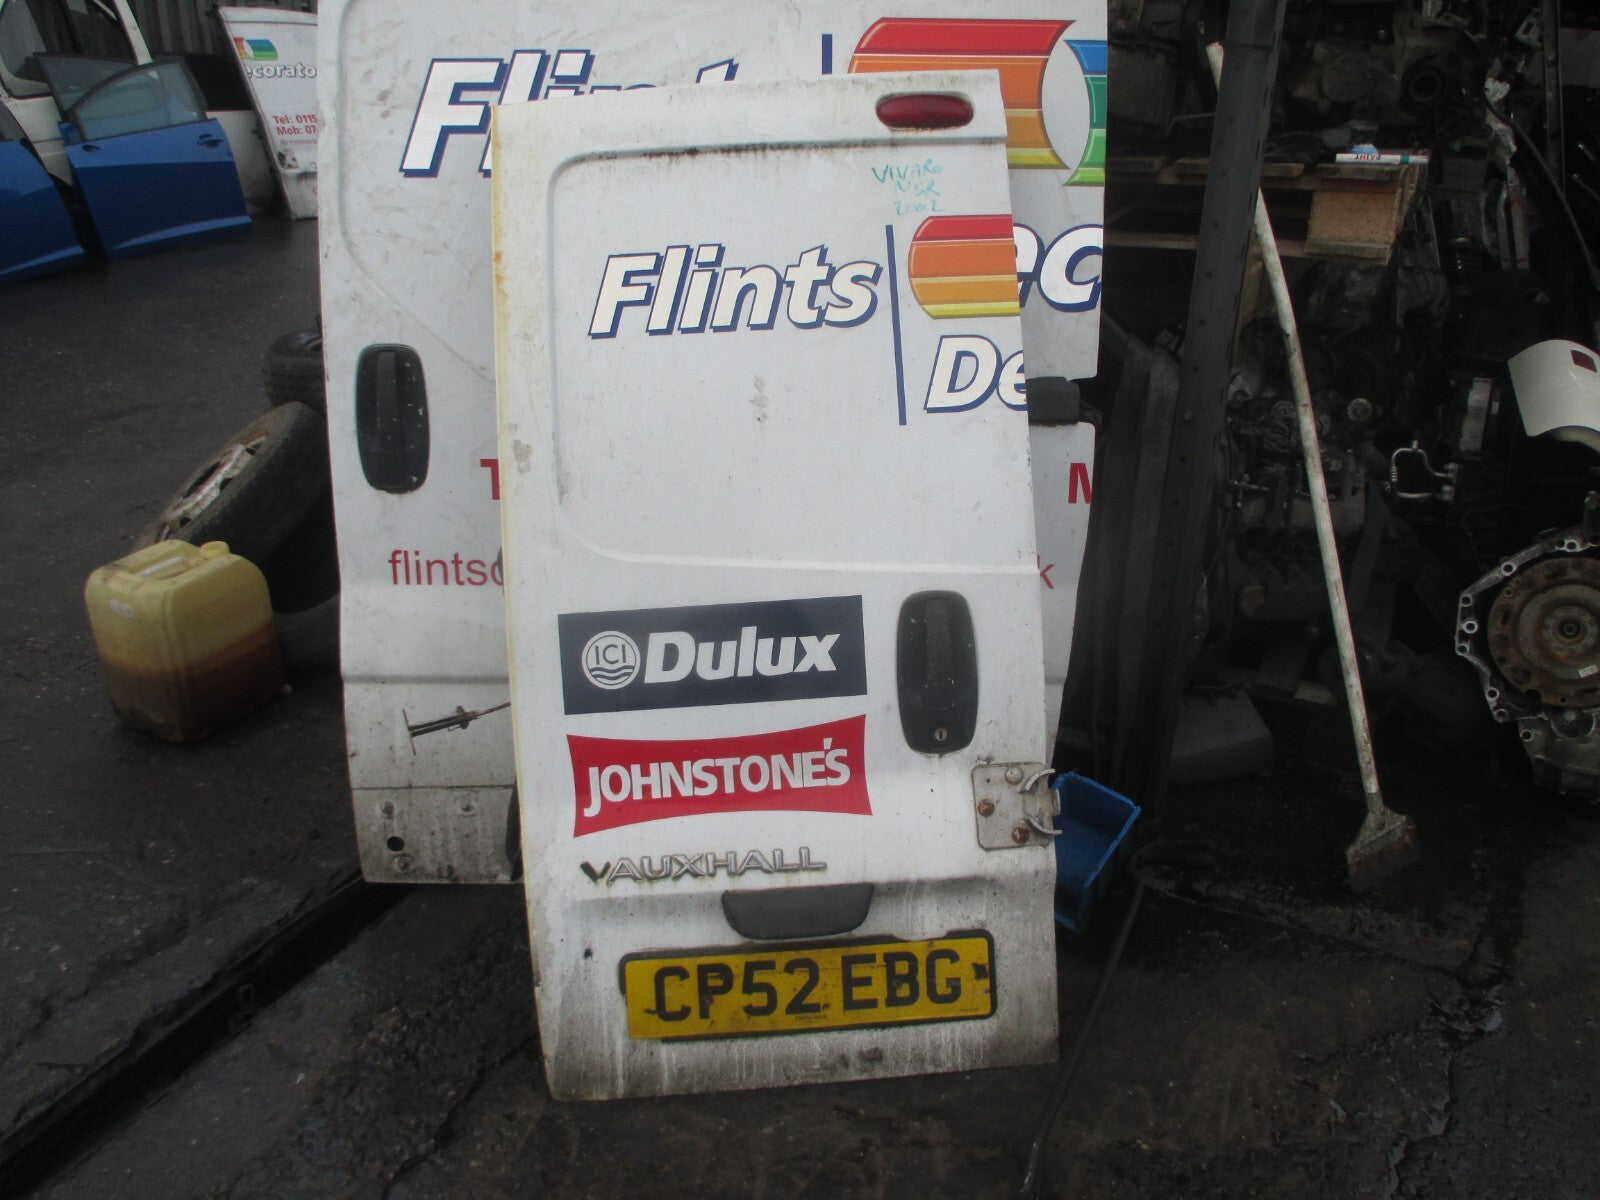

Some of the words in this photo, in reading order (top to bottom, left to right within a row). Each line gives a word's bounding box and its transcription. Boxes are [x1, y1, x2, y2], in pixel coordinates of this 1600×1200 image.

[273, 115, 293, 125] Tel:
[296, 114, 318, 124] 0115
[276, 126, 303, 135] Mob:
[588, 243, 884, 340] Flints
[594, 643, 628, 665] ICI
[644, 625, 841, 684] Dulux
[583, 737, 851, 818] JOHNSTONE'S
[580, 846, 828, 884] VAUXHALL
[652, 957, 823, 1022] CP52
[841, 949, 963, 1011] EBG
